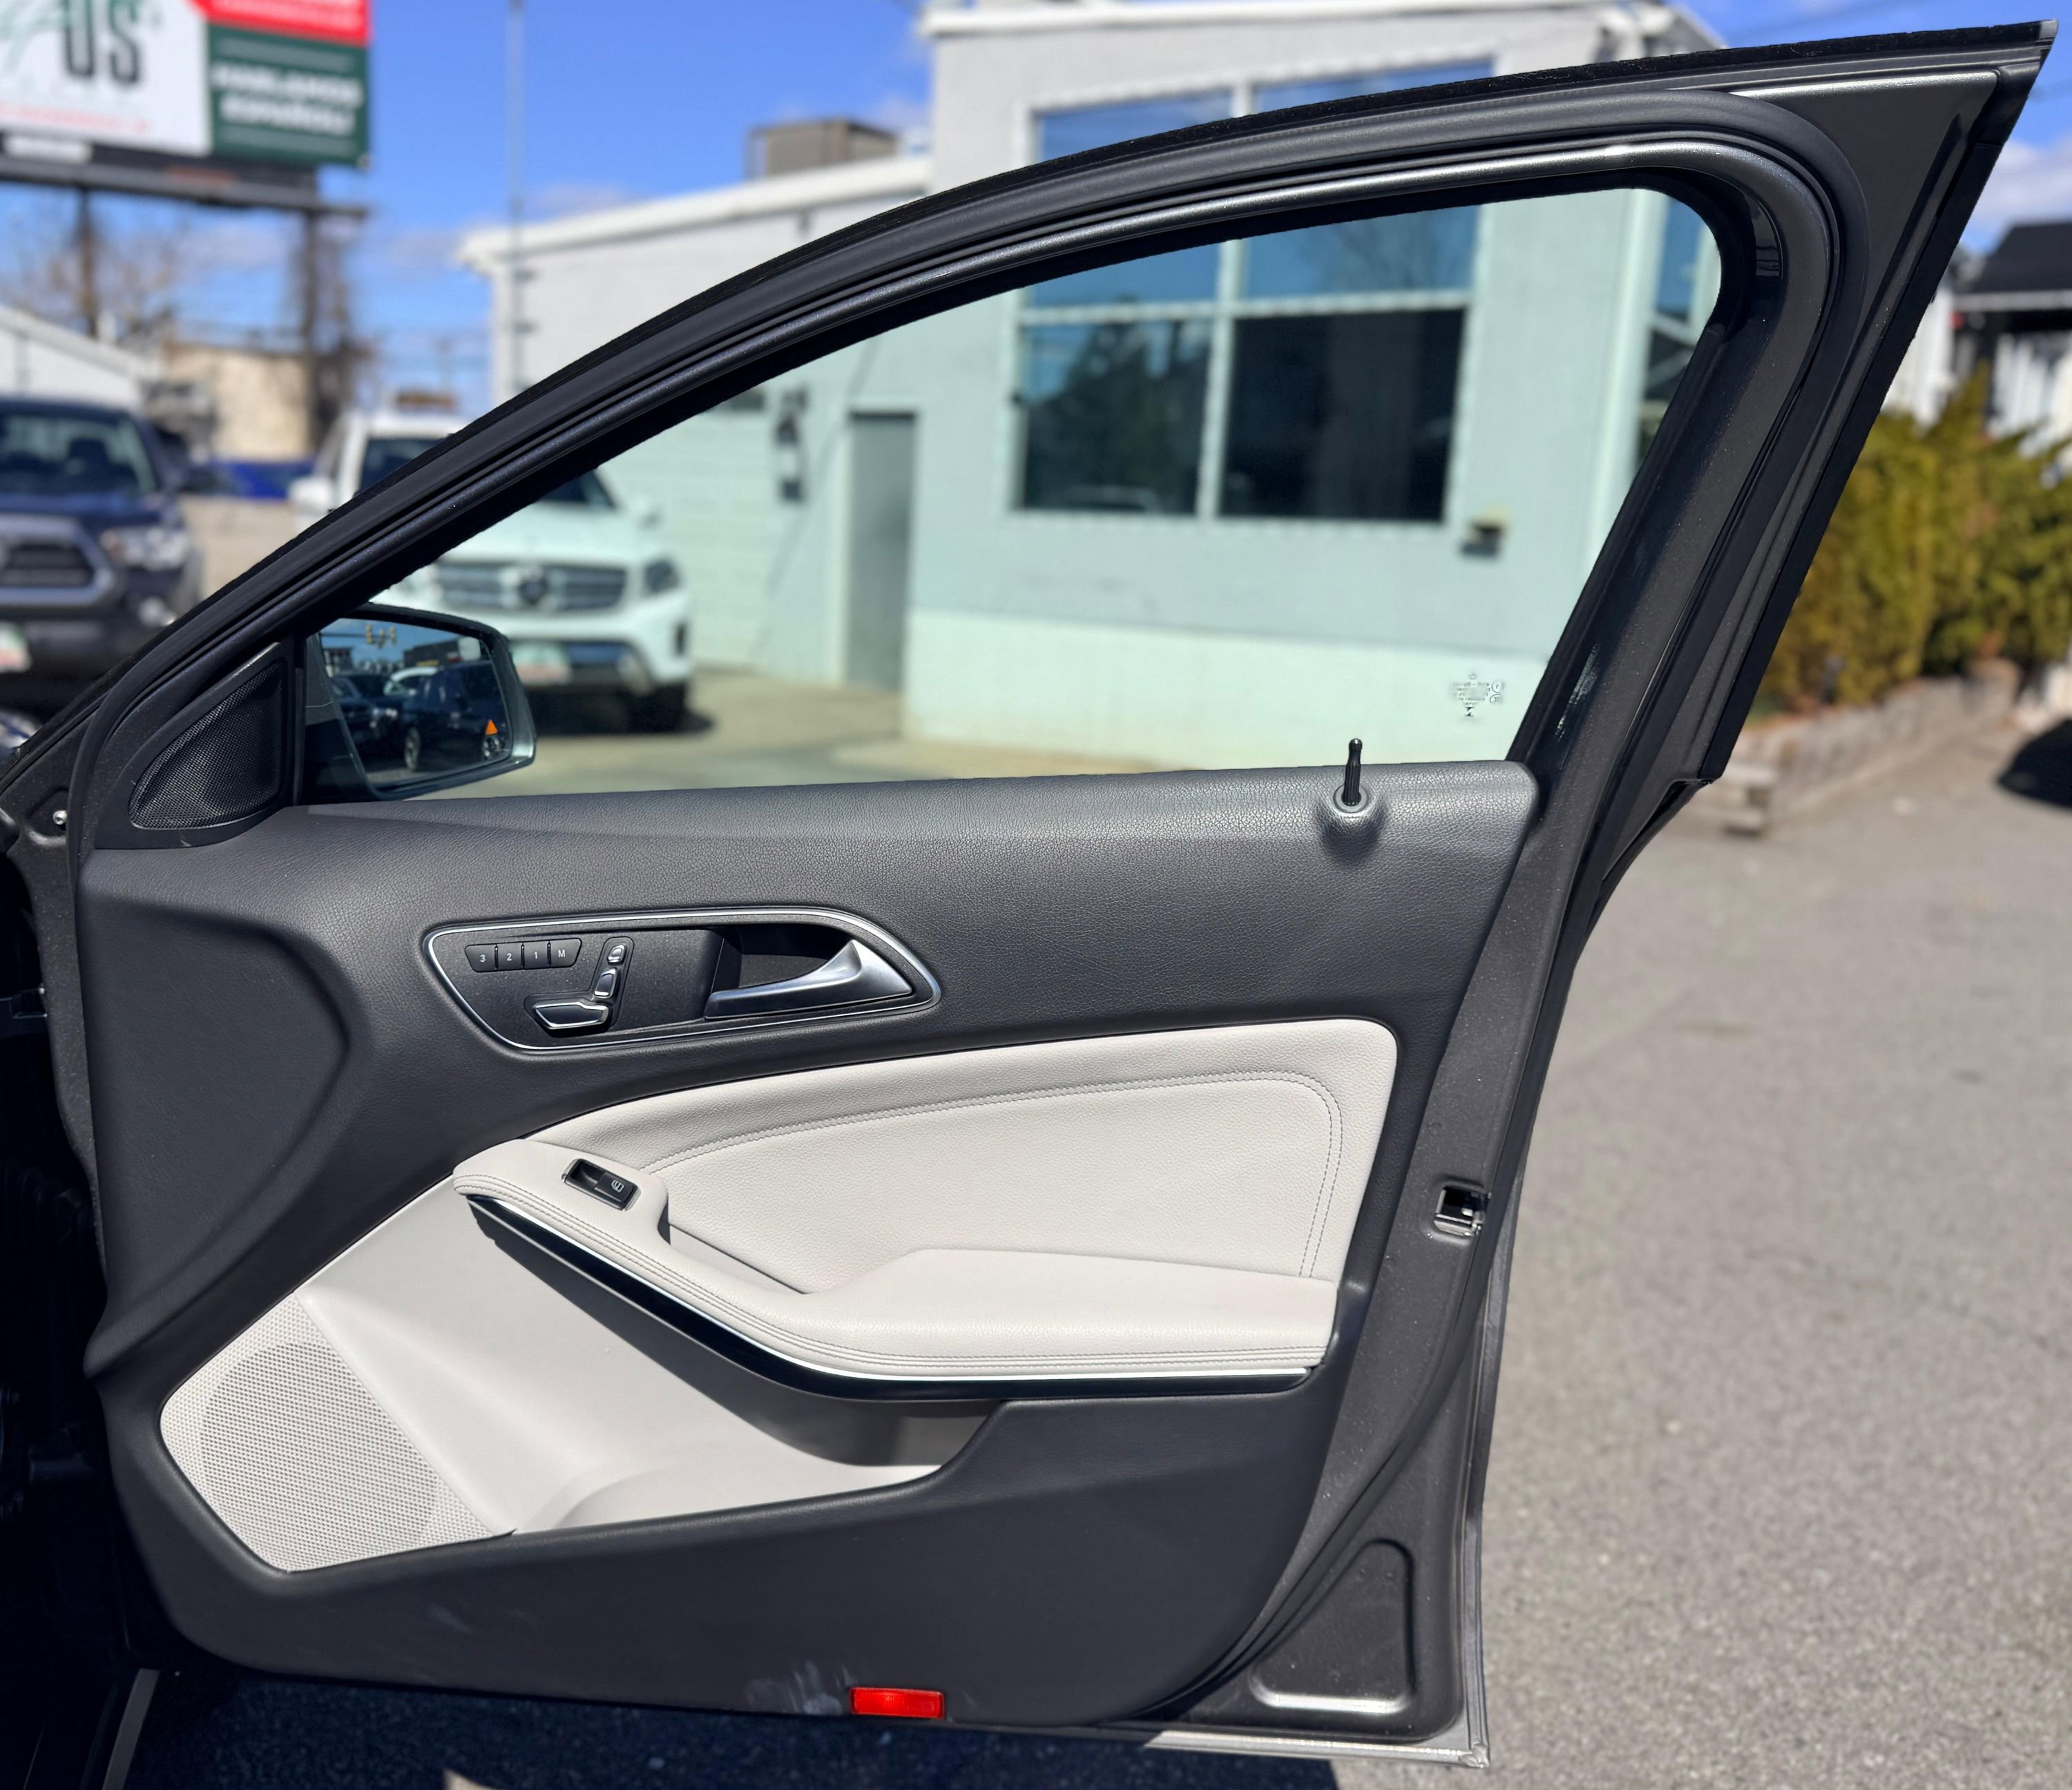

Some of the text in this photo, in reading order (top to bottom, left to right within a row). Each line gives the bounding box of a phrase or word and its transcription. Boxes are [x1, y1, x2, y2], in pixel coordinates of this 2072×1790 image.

[480, 954, 486, 963] 3
[506, 953, 512, 961] 2
[558, 950, 566, 958] M
